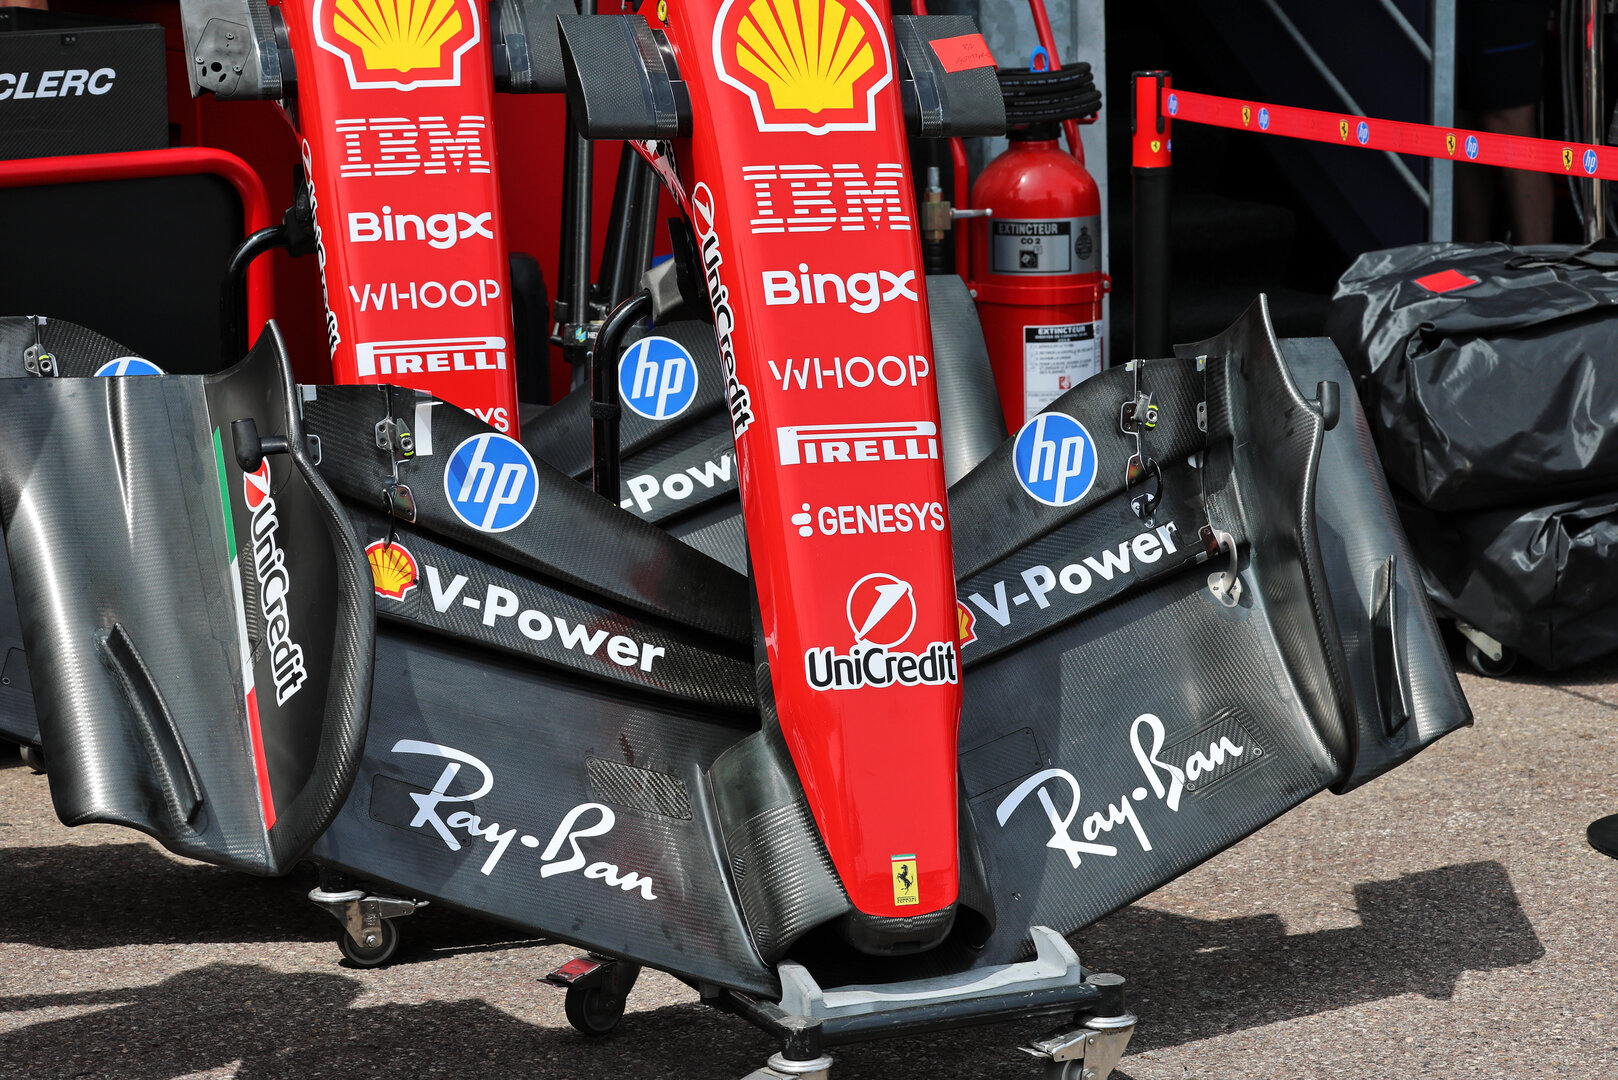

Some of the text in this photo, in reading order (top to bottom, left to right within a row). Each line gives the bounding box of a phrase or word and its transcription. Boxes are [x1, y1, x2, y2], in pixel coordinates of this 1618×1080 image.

[0, 67, 116, 100] CLERC
[335, 115, 490, 177] IBM
[742, 164, 911, 233] IBM
[999, 223, 1058, 235] EXTINCTEUR
[349, 280, 500, 311] WHOOP
[357, 337, 506, 376] PIRELLI
[703, 233, 754, 440] UniCredit
[1038, 326, 1086, 335] EXTINCTEUR
[629, 337, 687, 420] hp
[768, 355, 929, 390] WHOOP
[777, 421, 938, 465] PIRELLI
[1027, 413, 1086, 506] hp
[455, 433, 529, 533] hp
[818, 502, 945, 535] GENESYS
[968, 520, 1177, 627] V-Power
[251, 499, 306, 705] UniCredit
[425, 563, 665, 673] V-Power
[806, 643, 957, 689] UniCredit
